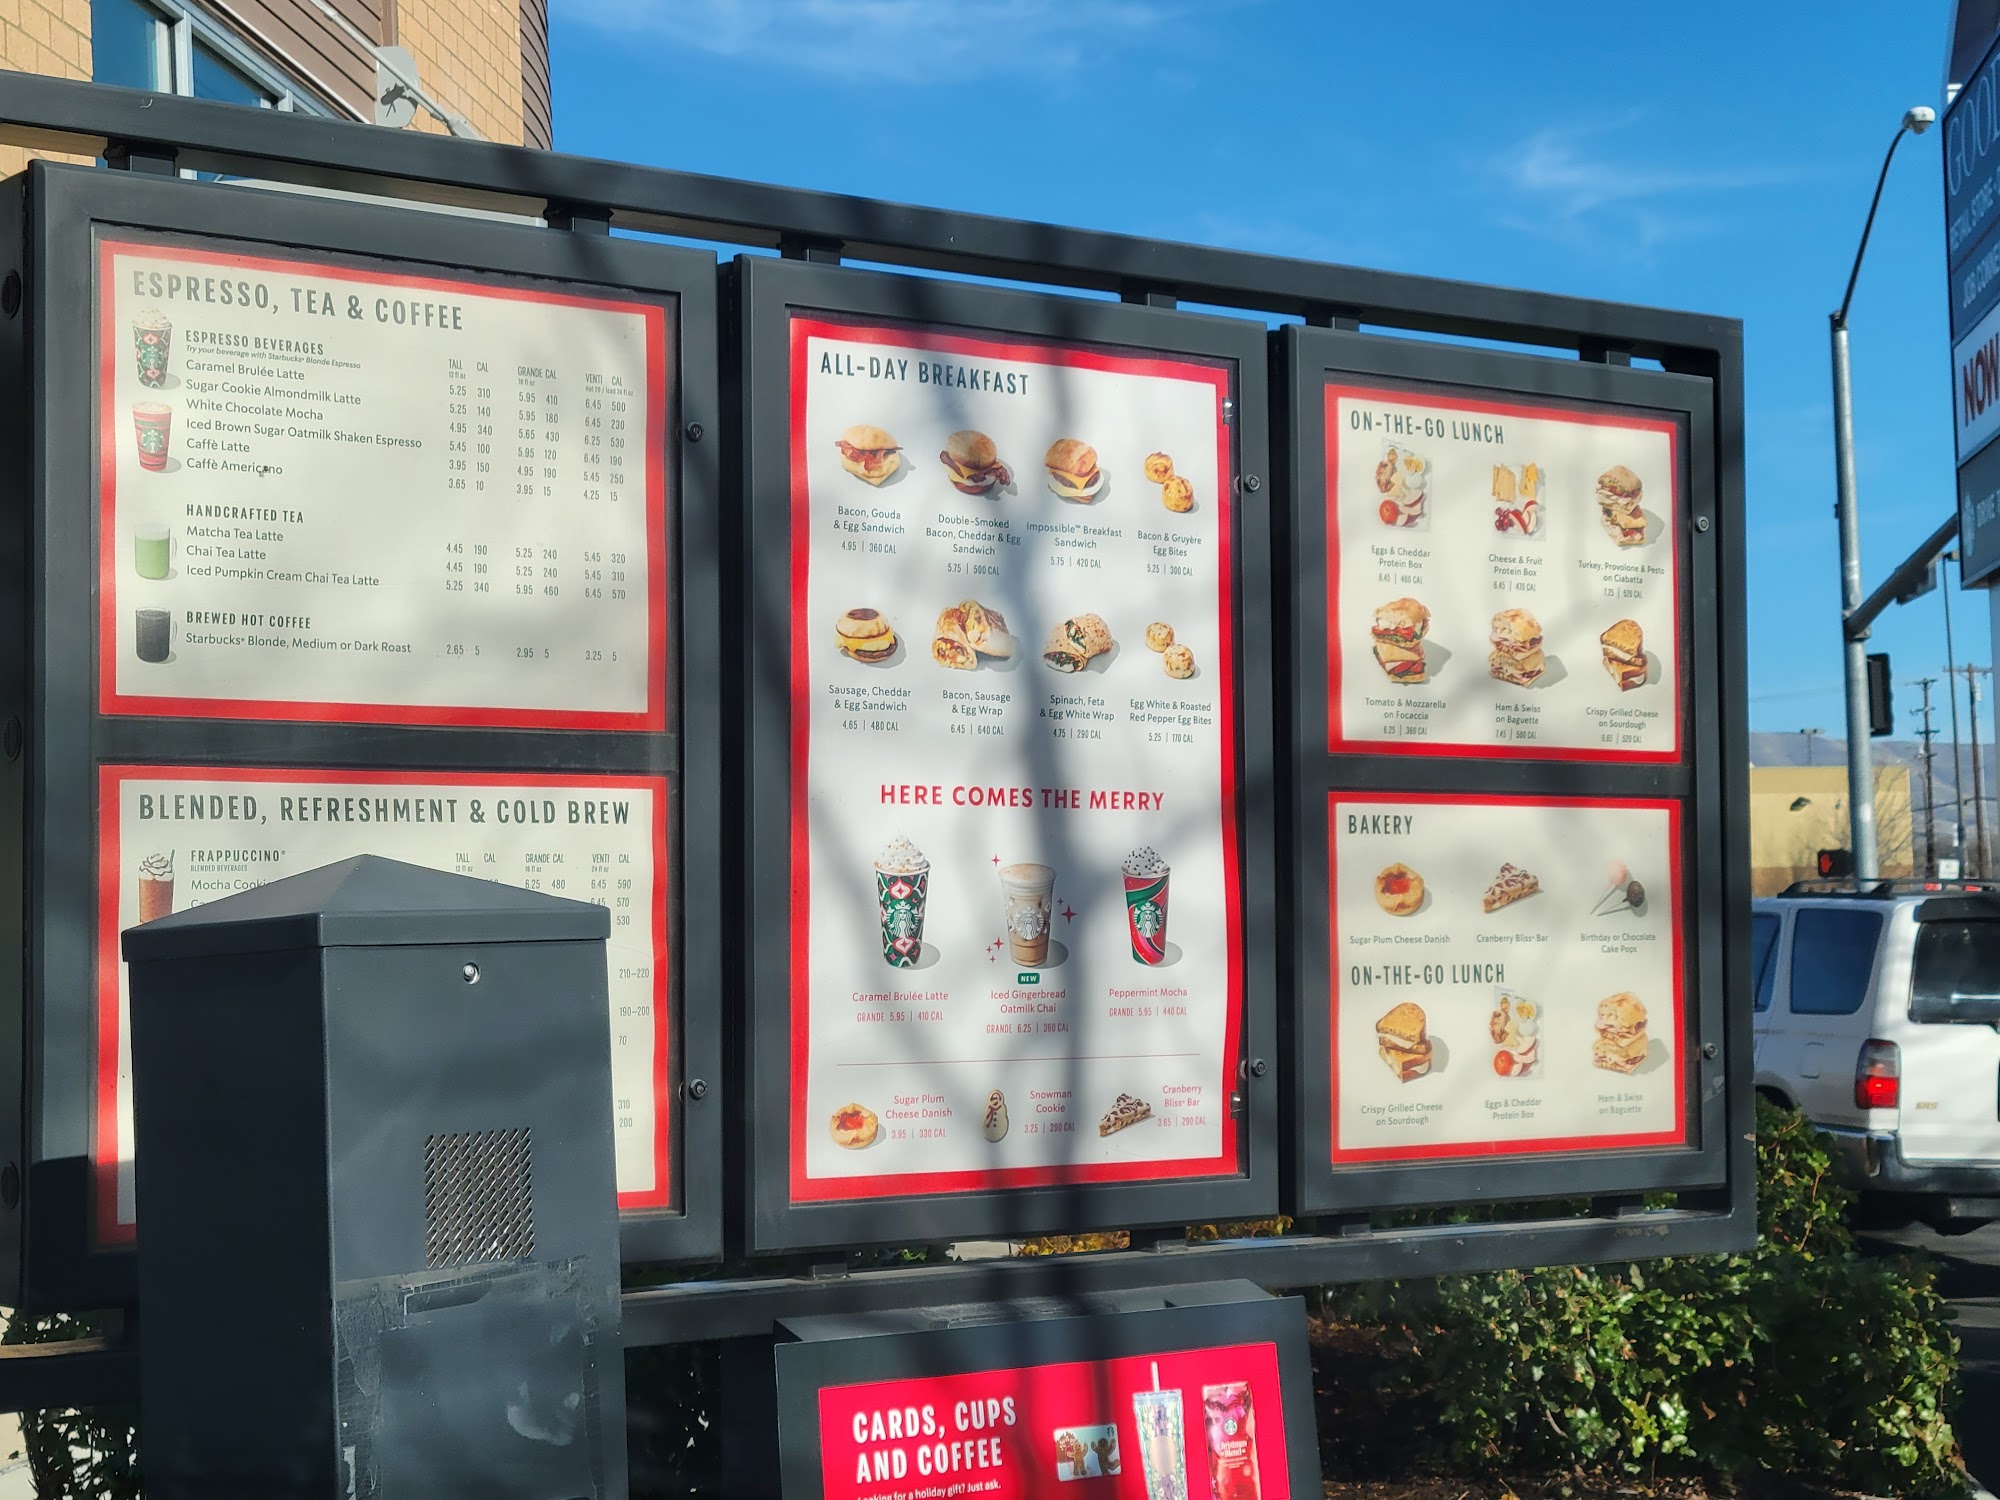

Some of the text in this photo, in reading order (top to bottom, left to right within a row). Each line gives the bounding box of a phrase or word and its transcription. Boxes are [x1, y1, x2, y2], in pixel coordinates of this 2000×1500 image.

[133, 271, 463, 331] ESPRESSO, TEA & COFFEE
[185, 329, 325, 356] ESPRESSO BEVERAGES
[186, 359, 305, 381] Caramel Brulée Latte
[448, 359, 489, 373] TALL CAL
[517, 366, 557, 380] GRANDE CAL
[585, 373, 623, 387] VENTI CAL
[820, 351, 1029, 396] ALL-DAY BREAKFAST
[186, 378, 362, 406] Sugar Cookie Almondmilk Latte
[449, 384, 491, 399] 5.25 310
[518, 391, 558, 406] 5.95 410
[186, 398, 324, 421] White Chocolate Mocha
[585, 398, 626, 413] 6.45 500
[186, 418, 422, 449] Iced Brown Sugar Oatmilk Shaken Espresso
[1350, 409, 1505, 445] ON-THE-GO LUNCH
[186, 438, 250, 453] Caffè Latte
[186, 503, 304, 524] HANDCRAFTED TEA
[838, 505, 901, 520] Bacon, Gouda
[833, 520, 905, 535] & Egg Sandwich
[938, 514, 1010, 529] Double-Smoked
[186, 525, 284, 542] Matcha Tea Latte
[925, 527, 1022, 546] Bacon, Cheddar & Egg
[1137, 530, 1202, 546] Bacon & Gruyère
[841, 540, 897, 554] 4.95 360 CAL
[952, 544, 996, 556] Sandwich
[1153, 546, 1188, 558] Egg Bites
[1371, 545, 1431, 559] Eggs & Cheddar
[1379, 558, 1423, 569] Protein Box
[186, 611, 312, 629] BREWED HOT COFFEE
[828, 684, 912, 698] Sausage, Cheddar
[942, 690, 1011, 704] Bacon, Sausage
[834, 699, 907, 712] & Egg Sandwich
[951, 704, 1003, 717] & Egg Wrap
[1365, 697, 1447, 710] Tomato & Mozzarella
[1396, 710, 1429, 720] Focaccia
[842, 720, 899, 732] 4.65 480 CAL
[880, 784, 1165, 811] HERE COMES THE MERRY
[139, 794, 630, 825] BLENDED, REFRESHMENT & COLD BREW
[1348, 814, 1414, 836] BAKERY
[190, 864, 248, 873] BLENDED BEVERAGES
[191, 879, 231, 891] Mocha
[525, 879, 566, 890] 6.25 480
[591, 879, 632, 890] 6.45 590
[616, 897, 630, 908] 570
[616, 915, 631, 926] 530
[1350, 934, 1451, 946] Sugar Plum Cheese Danish
[1601, 945, 1638, 954] Cake Pops
[1351, 963, 1506, 987] ON-THE-GO LUNCH
[852, 990, 949, 1003] Caramel Brulée Latte
[991, 988, 1066, 1002] Iced Gingerbread
[1109, 988, 1188, 1000] Peppermint Mocha
[1000, 1003, 1057, 1014] Oatmilk Chai
[857, 1010, 944, 1023] GRANDE 5.95 410 CAL
[618, 1035, 627, 1046] 70
[894, 1094, 945, 1106] Sugar Plum
[1030, 1089, 1073, 1100] Snowman
[618, 1099, 631, 1110] 310
[1036, 1103, 1066, 1114] Cookie
[885, 1108, 953, 1120] Cheese Danish
[619, 1117, 633, 1128] 200
[852, 1396, 1017, 1444] CARDS, CUPS
[855, 1437, 1003, 1485] AND COFFEE
[915, 1487, 947, 1500] holiday
[947, 1483, 966, 1498] gift?
[966, 1481, 984, 1493] Just
[985, 1479, 1002, 1491] ask.
